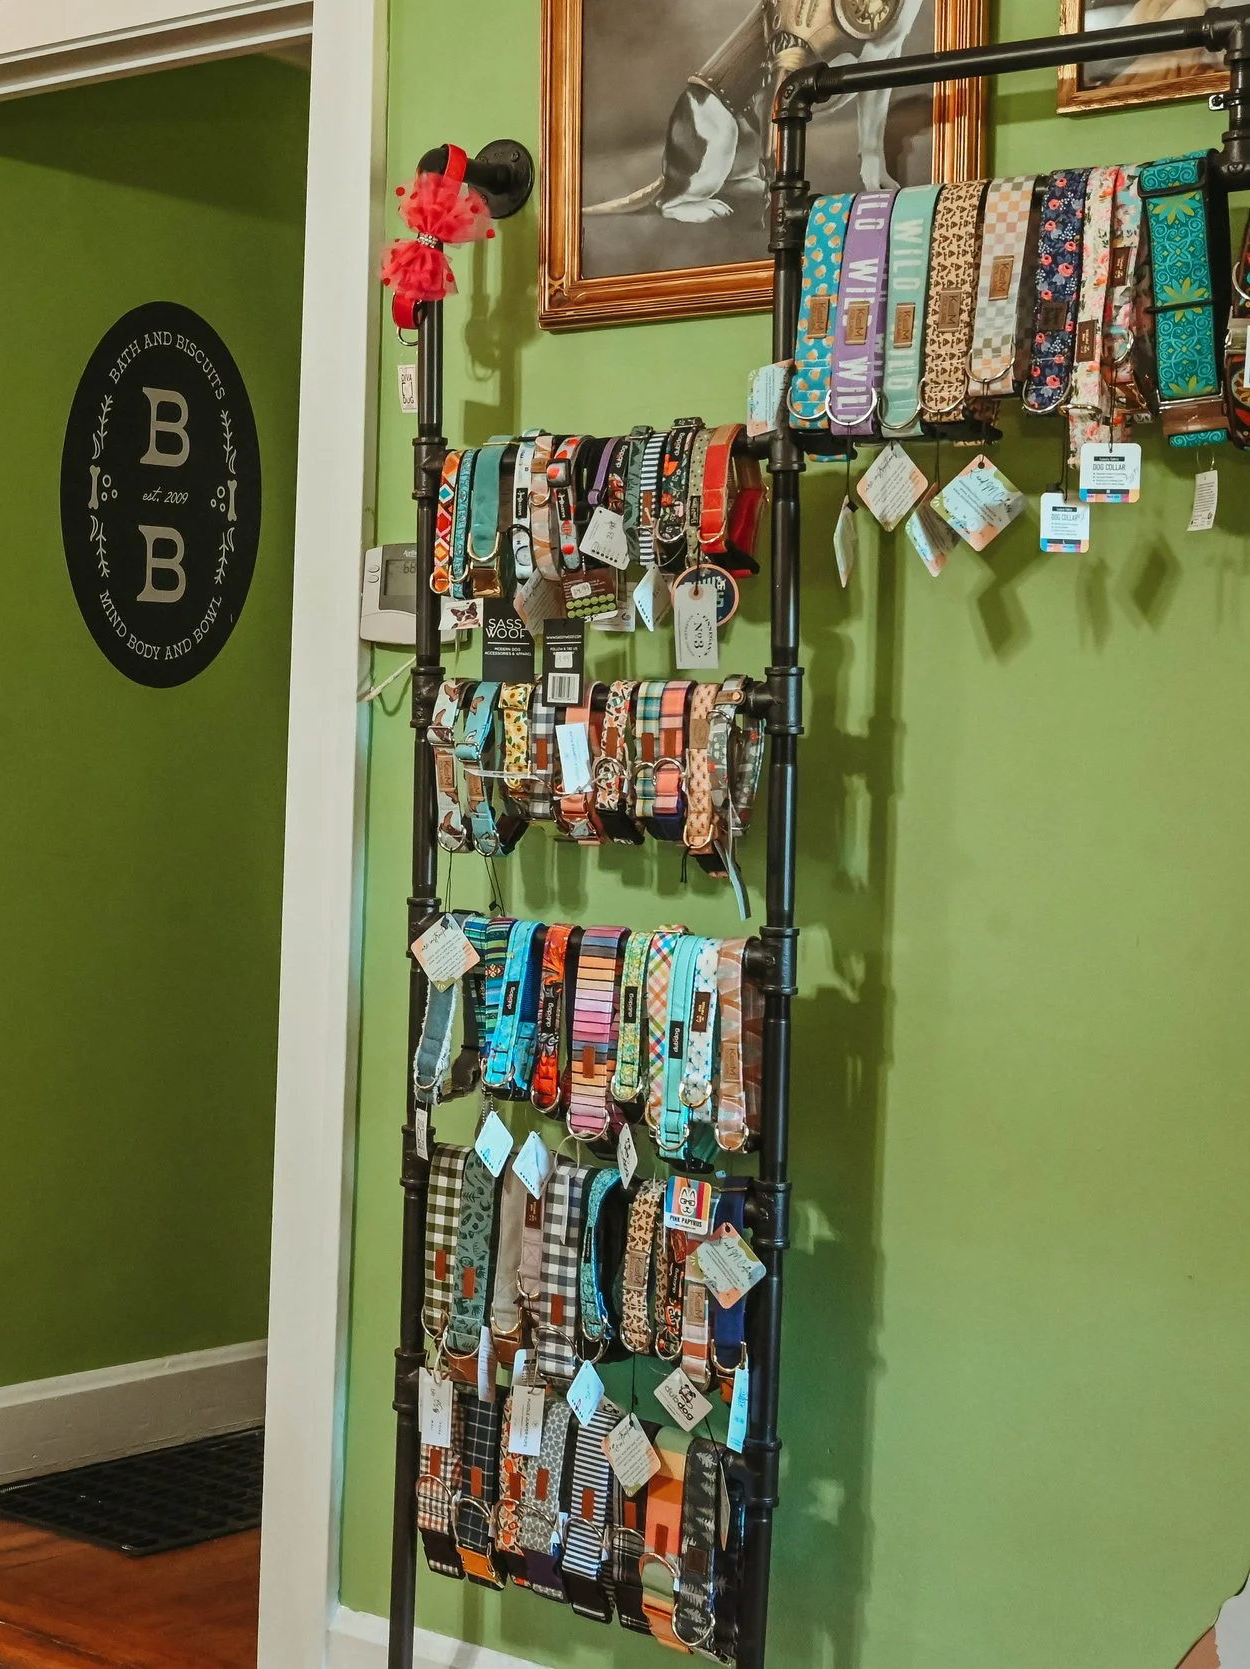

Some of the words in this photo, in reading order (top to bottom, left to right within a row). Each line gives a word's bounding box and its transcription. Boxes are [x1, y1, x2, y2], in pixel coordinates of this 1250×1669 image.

[854, 193, 890, 231] ILD
[893, 218, 925, 291] WILD
[842, 257, 879, 327] WIL
[108, 342, 141, 384] BATH
[144, 332, 172, 350] AND
[176, 334, 226, 400] BISCUITS
[140, 386, 190, 467] B
[674, 432, 685, 456] dubdog
[1093, 463, 1104, 471] DOG
[1105, 463, 1126, 471] COLLAR
[142, 486, 160, 503] est.
[164, 491, 189, 505] 2009
[1051, 513, 1060, 521] DOG
[136, 525, 187, 604] B
[99, 589, 127, 638] MIND
[126, 633, 161, 661] BODY
[164, 639, 192, 660] AND
[192, 595, 222, 645] BOWL
[507, 986, 515, 1010] dubdog
[545, 1002, 554, 1028] dubdog
[673, 1027, 681, 1053] dubdog
[669, 1214, 681, 1223] PINK
[681, 1216, 702, 1228] PAPYRUS
[664, 1385, 694, 1421] dubdog
